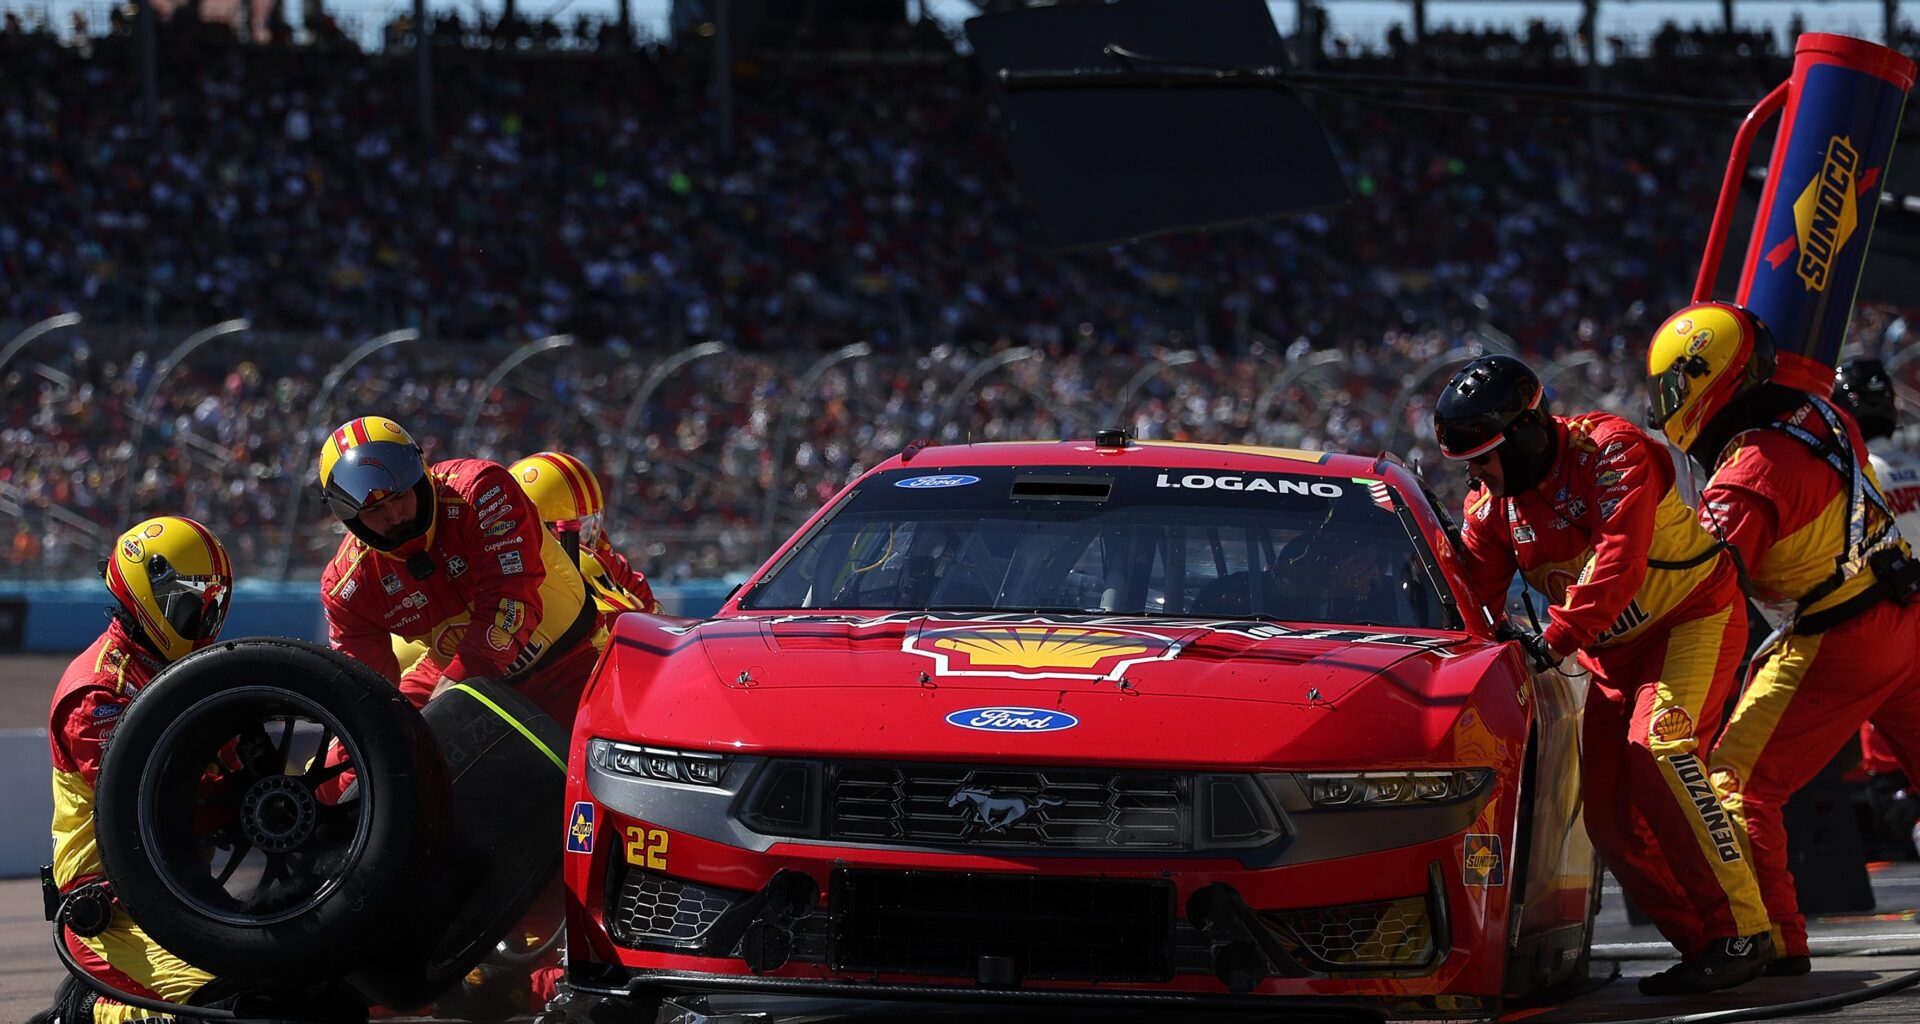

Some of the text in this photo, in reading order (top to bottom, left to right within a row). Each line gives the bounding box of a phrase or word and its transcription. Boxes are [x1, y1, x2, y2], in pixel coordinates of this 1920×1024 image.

[1799, 142, 1857, 291] SUNOCO
[909, 476, 965, 487] Ford
[1156, 474, 1343, 498] LOGANO
[479, 486, 500, 504] NASCAR
[484, 521, 516, 537] SUNOCO
[484, 538, 517, 552] Capgemini
[341, 580, 356, 600] OMP
[970, 709, 1054, 729] Ford
[1668, 752, 1742, 864] PENNZOIL
[626, 825, 669, 871] 22
